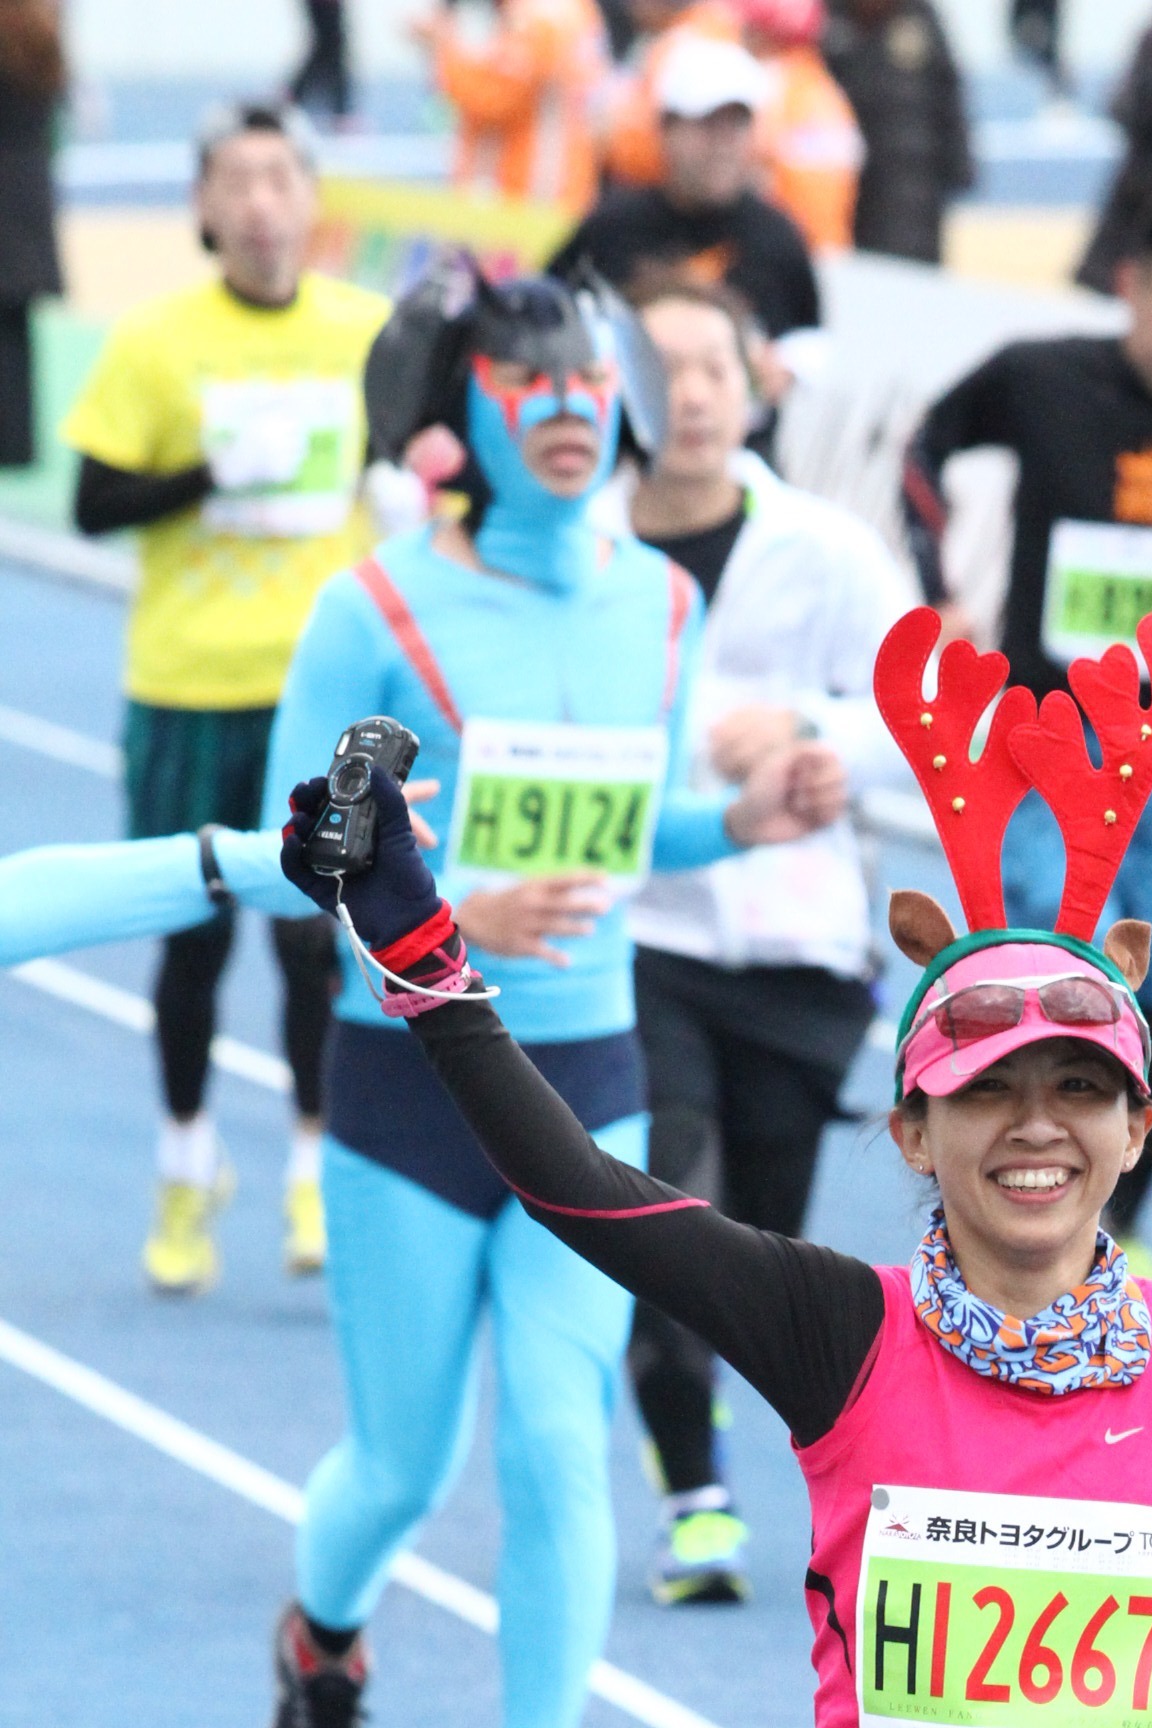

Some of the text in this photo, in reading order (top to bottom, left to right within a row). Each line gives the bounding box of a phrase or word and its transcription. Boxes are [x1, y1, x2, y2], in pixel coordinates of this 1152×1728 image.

[460, 781, 643, 864] H9124
[926, 1516, 1134, 1555] 奈良トヨタグループ
